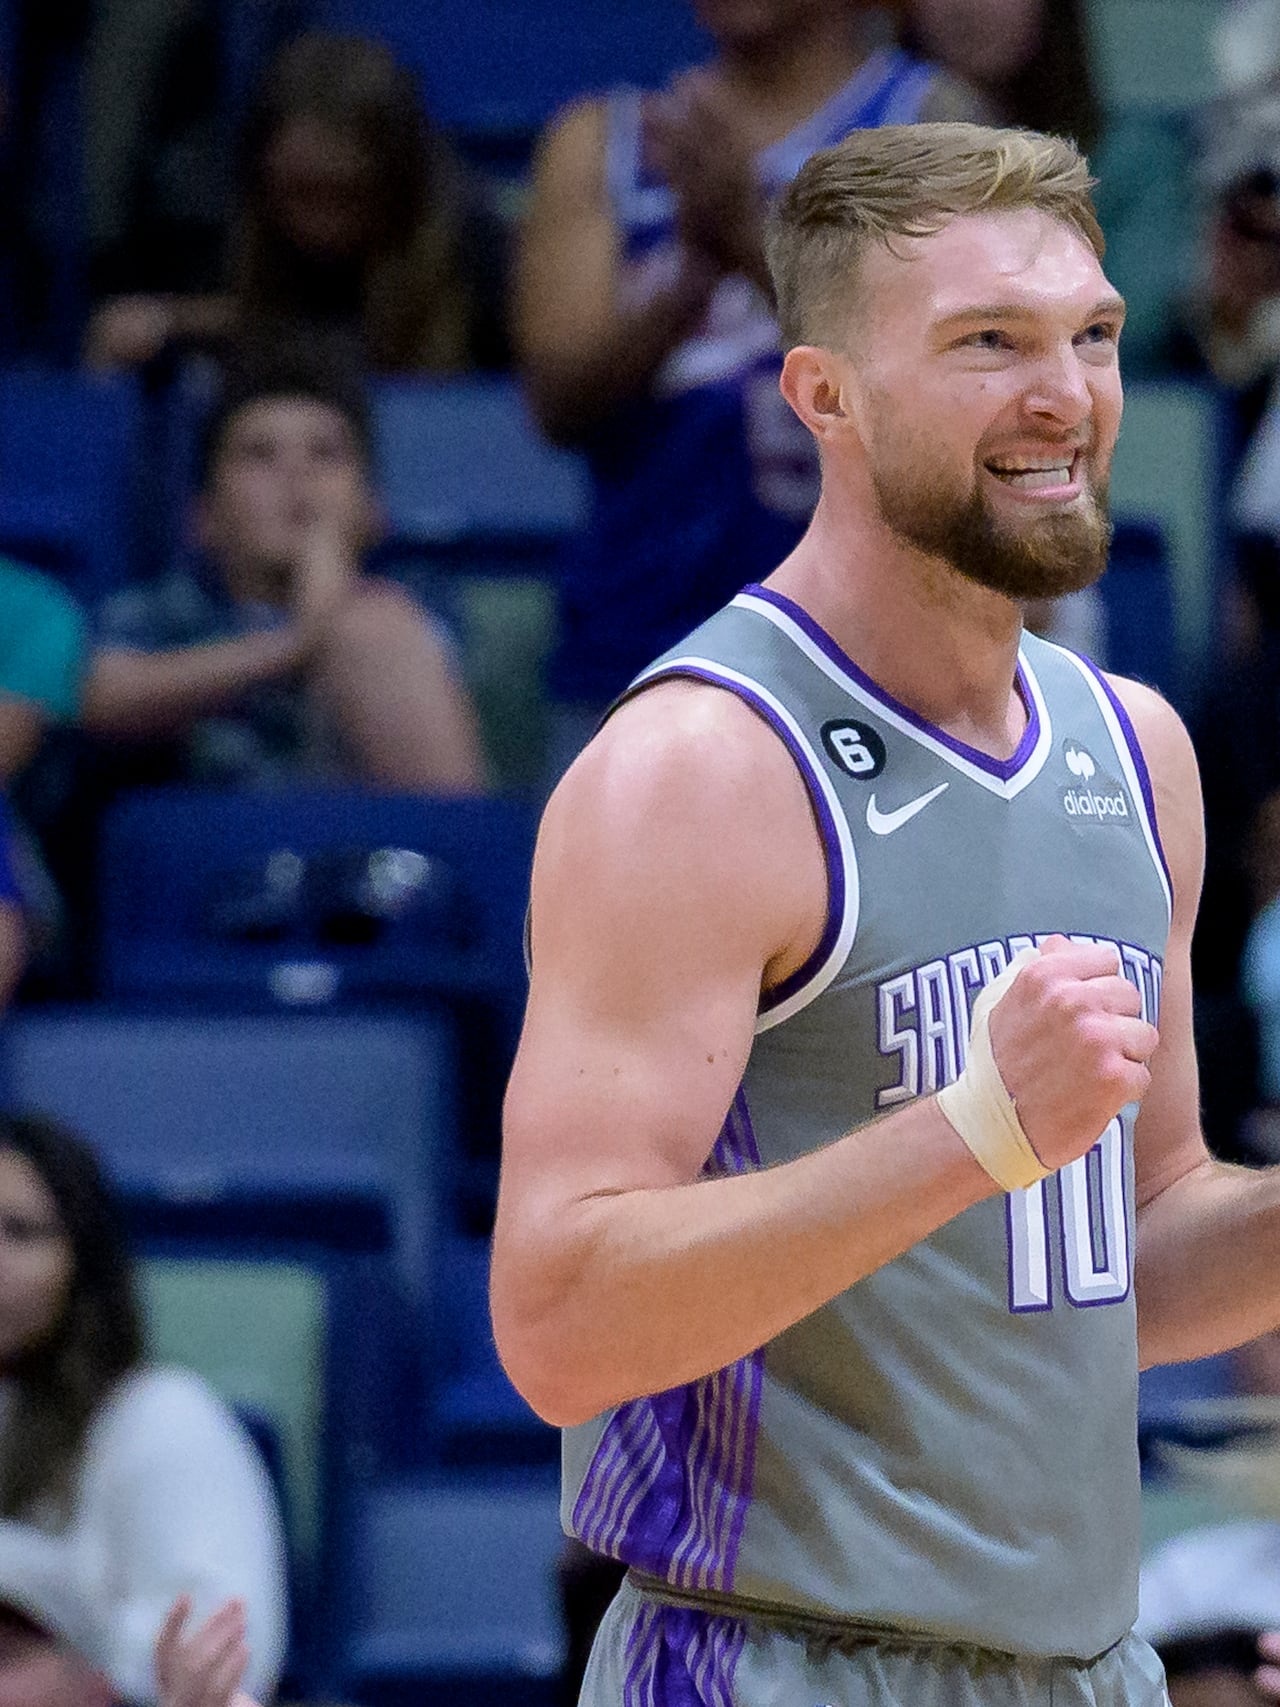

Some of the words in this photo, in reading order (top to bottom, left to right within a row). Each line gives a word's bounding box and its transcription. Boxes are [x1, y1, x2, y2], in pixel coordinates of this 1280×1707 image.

[829, 727, 875, 773] 6
[1064, 791, 1129, 820] dialpad
[1005, 1113, 1130, 1314] 10
